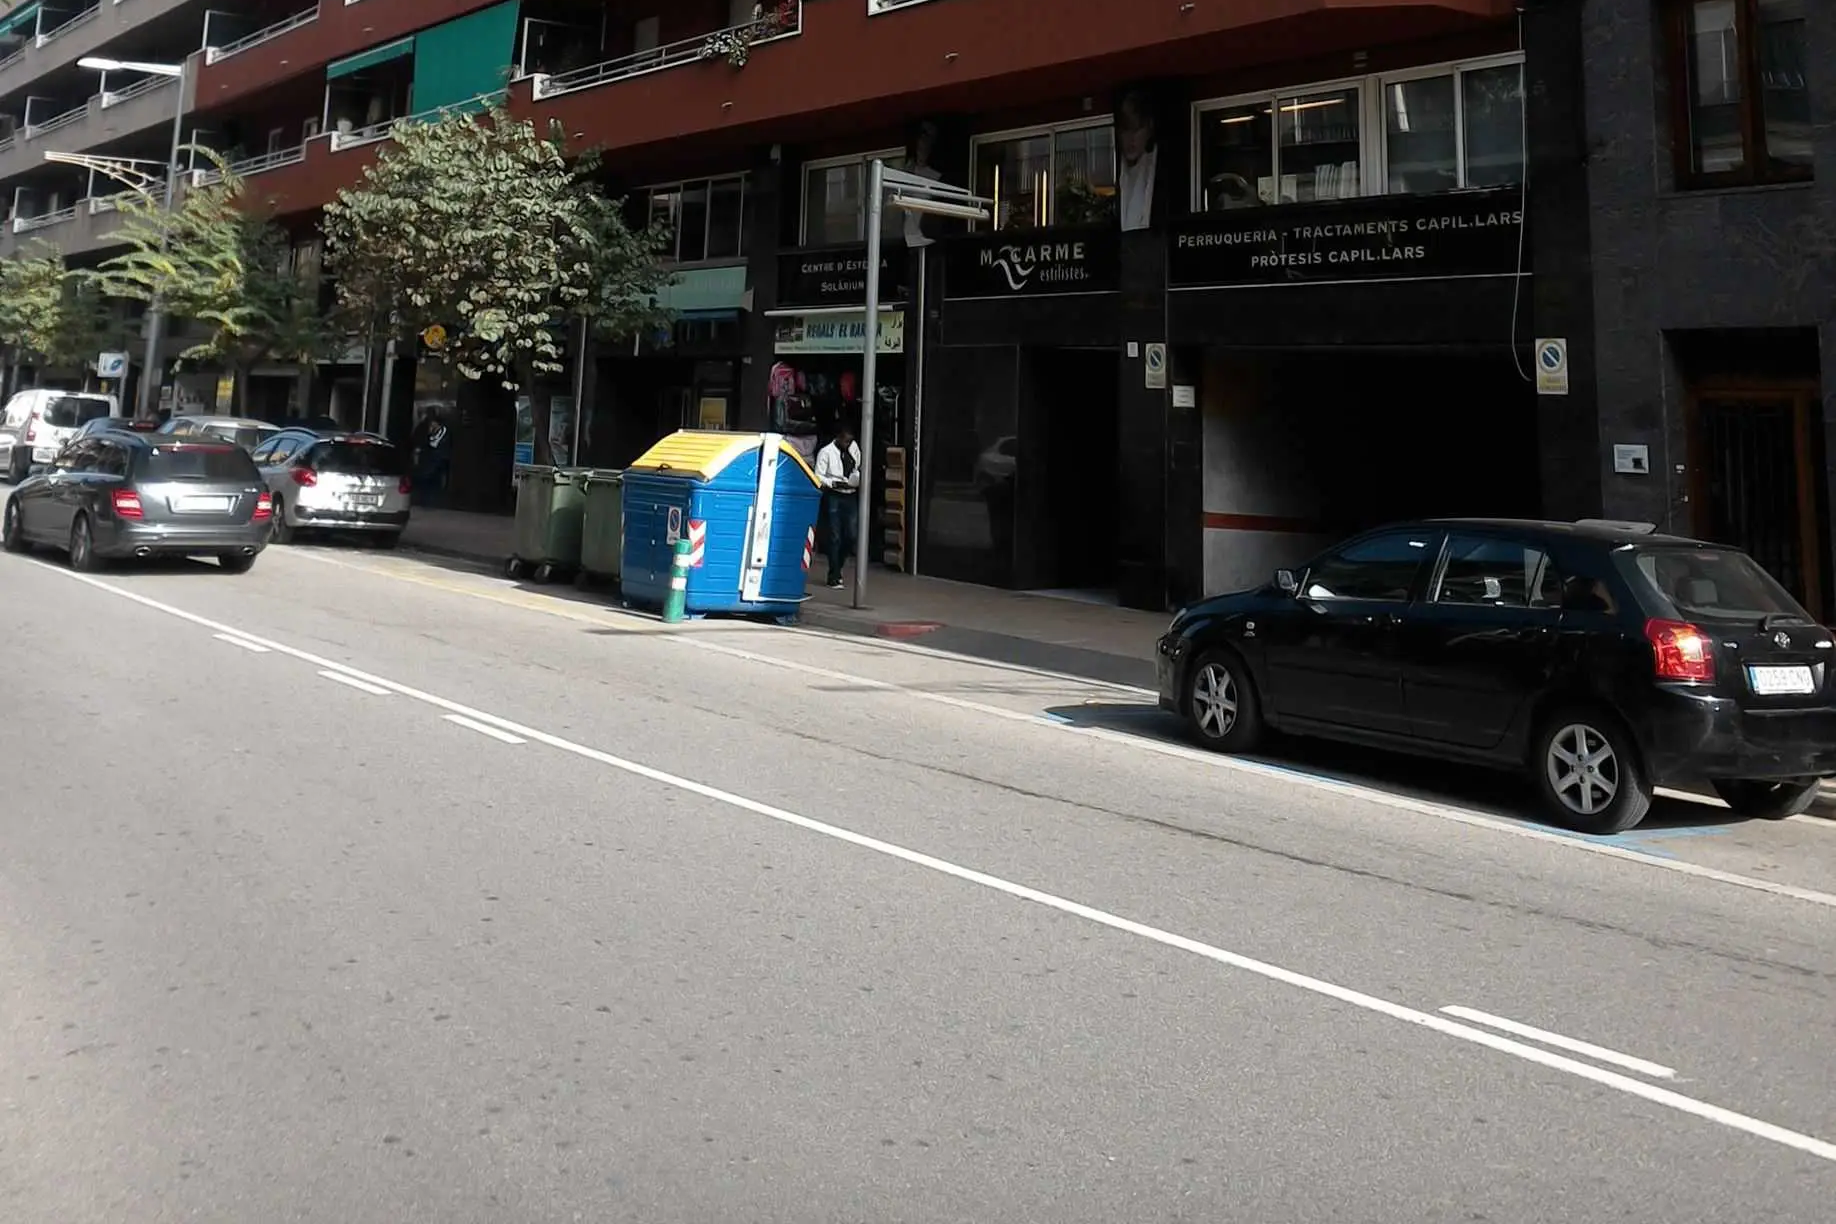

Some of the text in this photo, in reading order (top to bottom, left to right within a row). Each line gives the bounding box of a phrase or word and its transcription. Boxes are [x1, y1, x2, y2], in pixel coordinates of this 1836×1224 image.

[1178, 229, 1277, 249] PERRUQUERIA
[1292, 219, 1409, 240] TRACTAMENTS
[1251, 249, 1322, 268] PRÒTESIS
